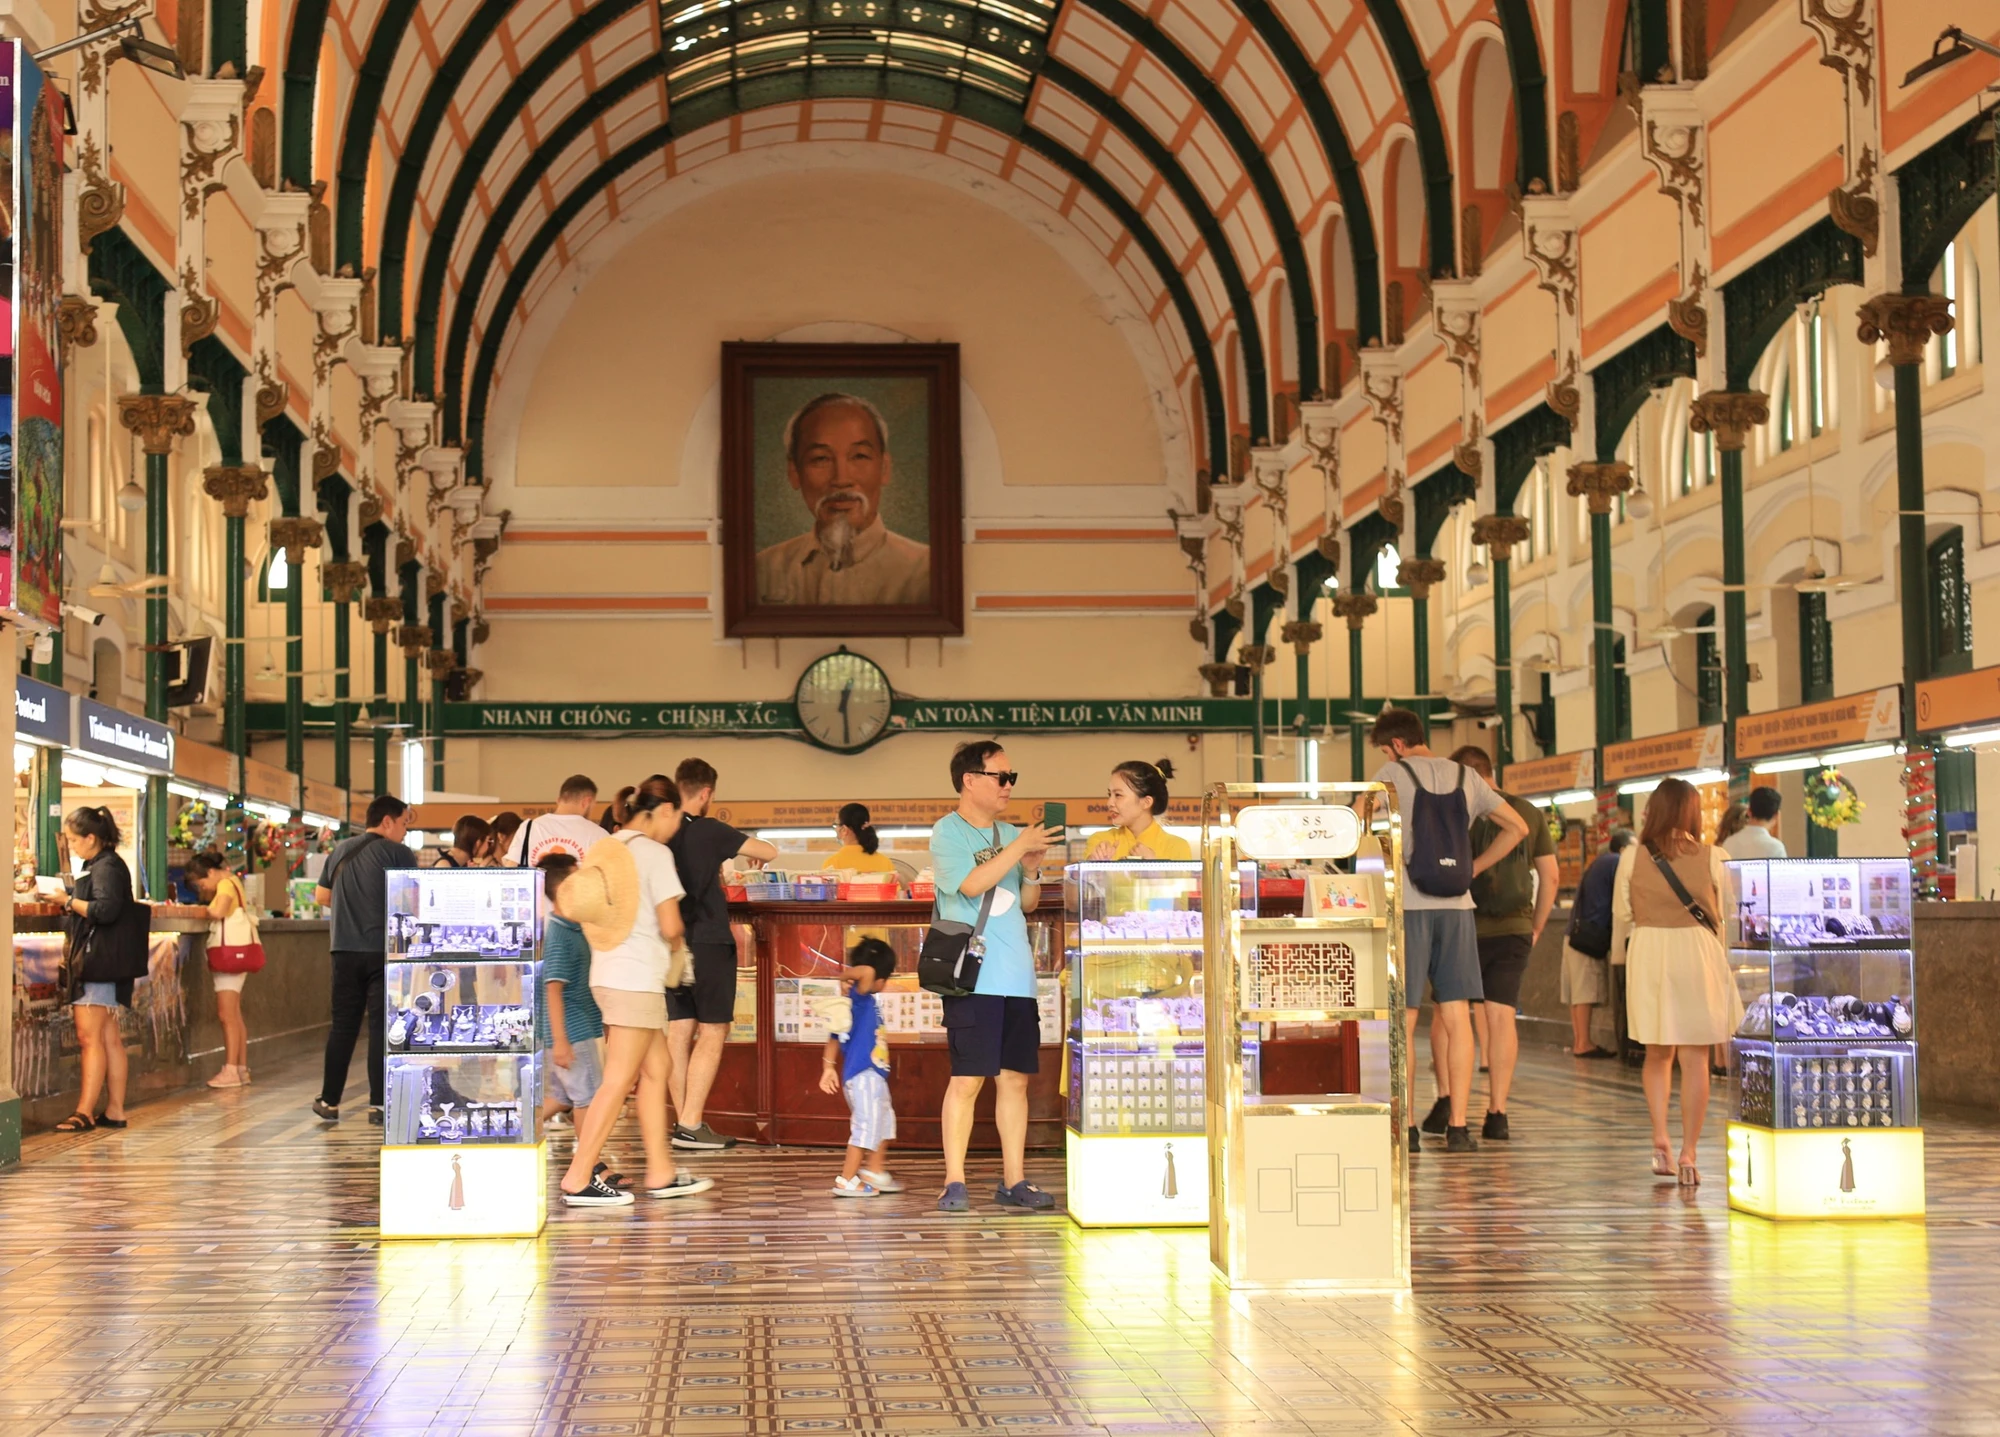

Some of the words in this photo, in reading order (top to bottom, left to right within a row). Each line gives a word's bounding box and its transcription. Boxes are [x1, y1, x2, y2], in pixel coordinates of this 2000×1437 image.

[482, 709, 553, 725] NHANH
[560, 705, 632, 725] CHÓNG
[658, 705, 726, 725] CHÍNH
[736, 705, 778, 725] XÁC
[914, 707, 938, 722] AN
[942, 703, 995, 723] TOÀN
[1009, 703, 1055, 726] TIỆN
[1059, 705, 1092, 726] LỢI
[1107, 703, 1146, 722] VĂN
[1152, 706, 1203, 722] MINH
